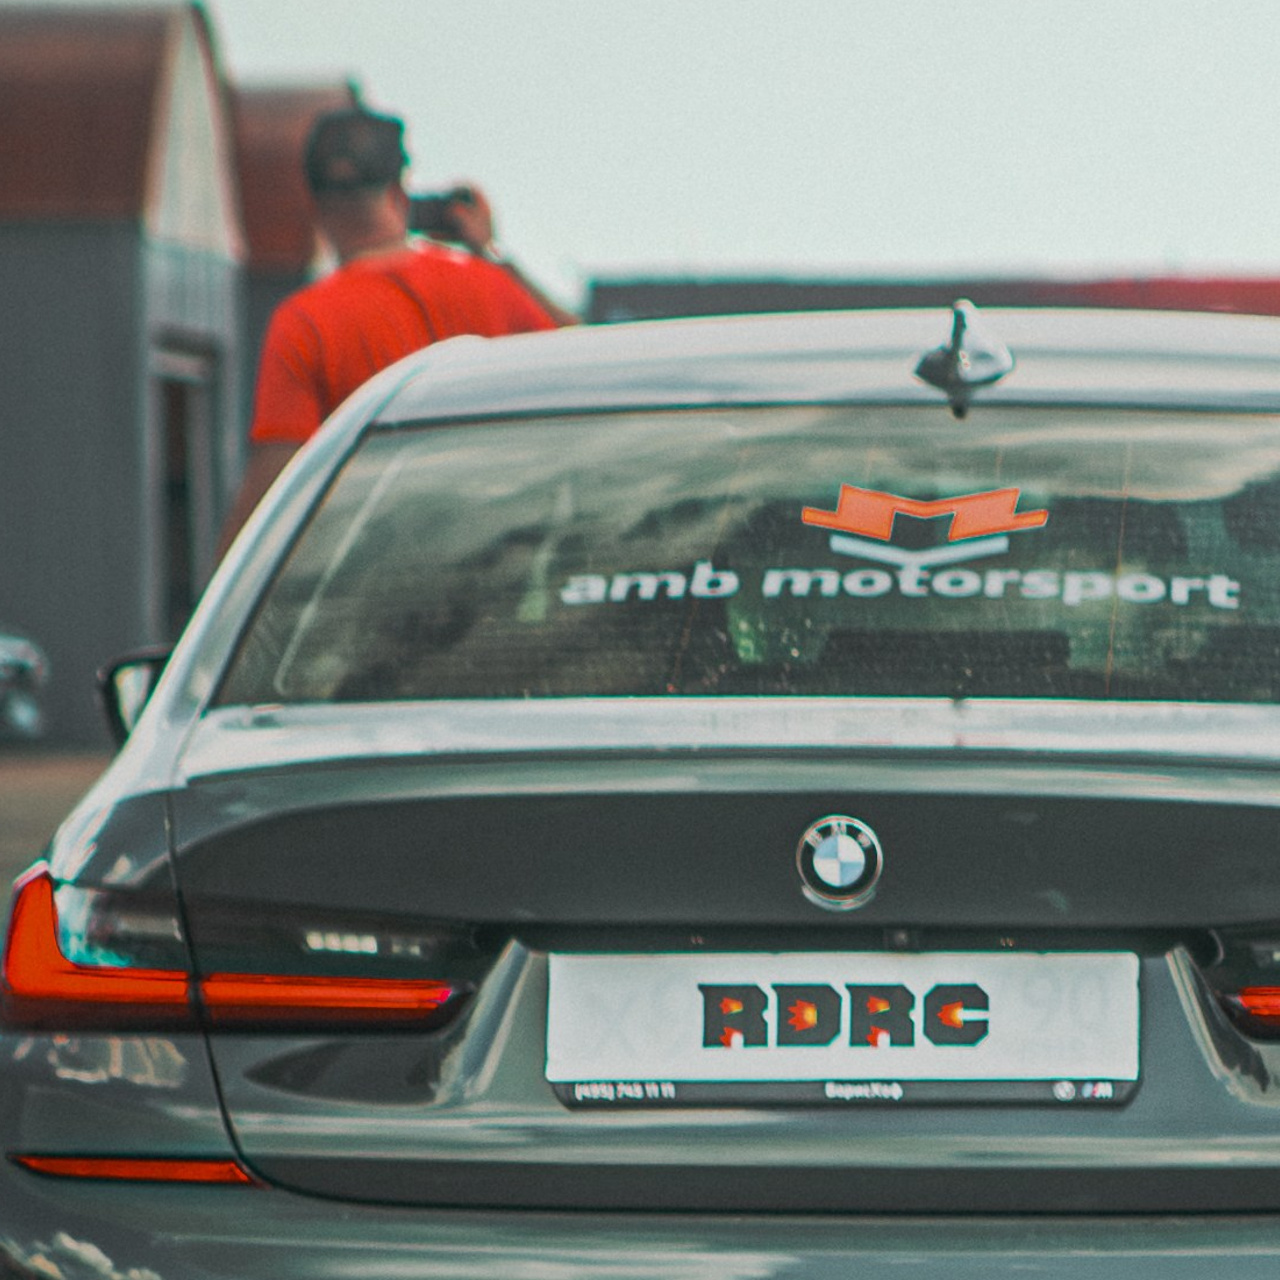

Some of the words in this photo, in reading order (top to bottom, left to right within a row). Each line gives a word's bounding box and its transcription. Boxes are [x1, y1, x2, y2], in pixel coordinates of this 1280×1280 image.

[561, 561, 739, 604] amb
[762, 566, 1240, 609] motorsport
[698, 983, 989, 1047] RDRC
